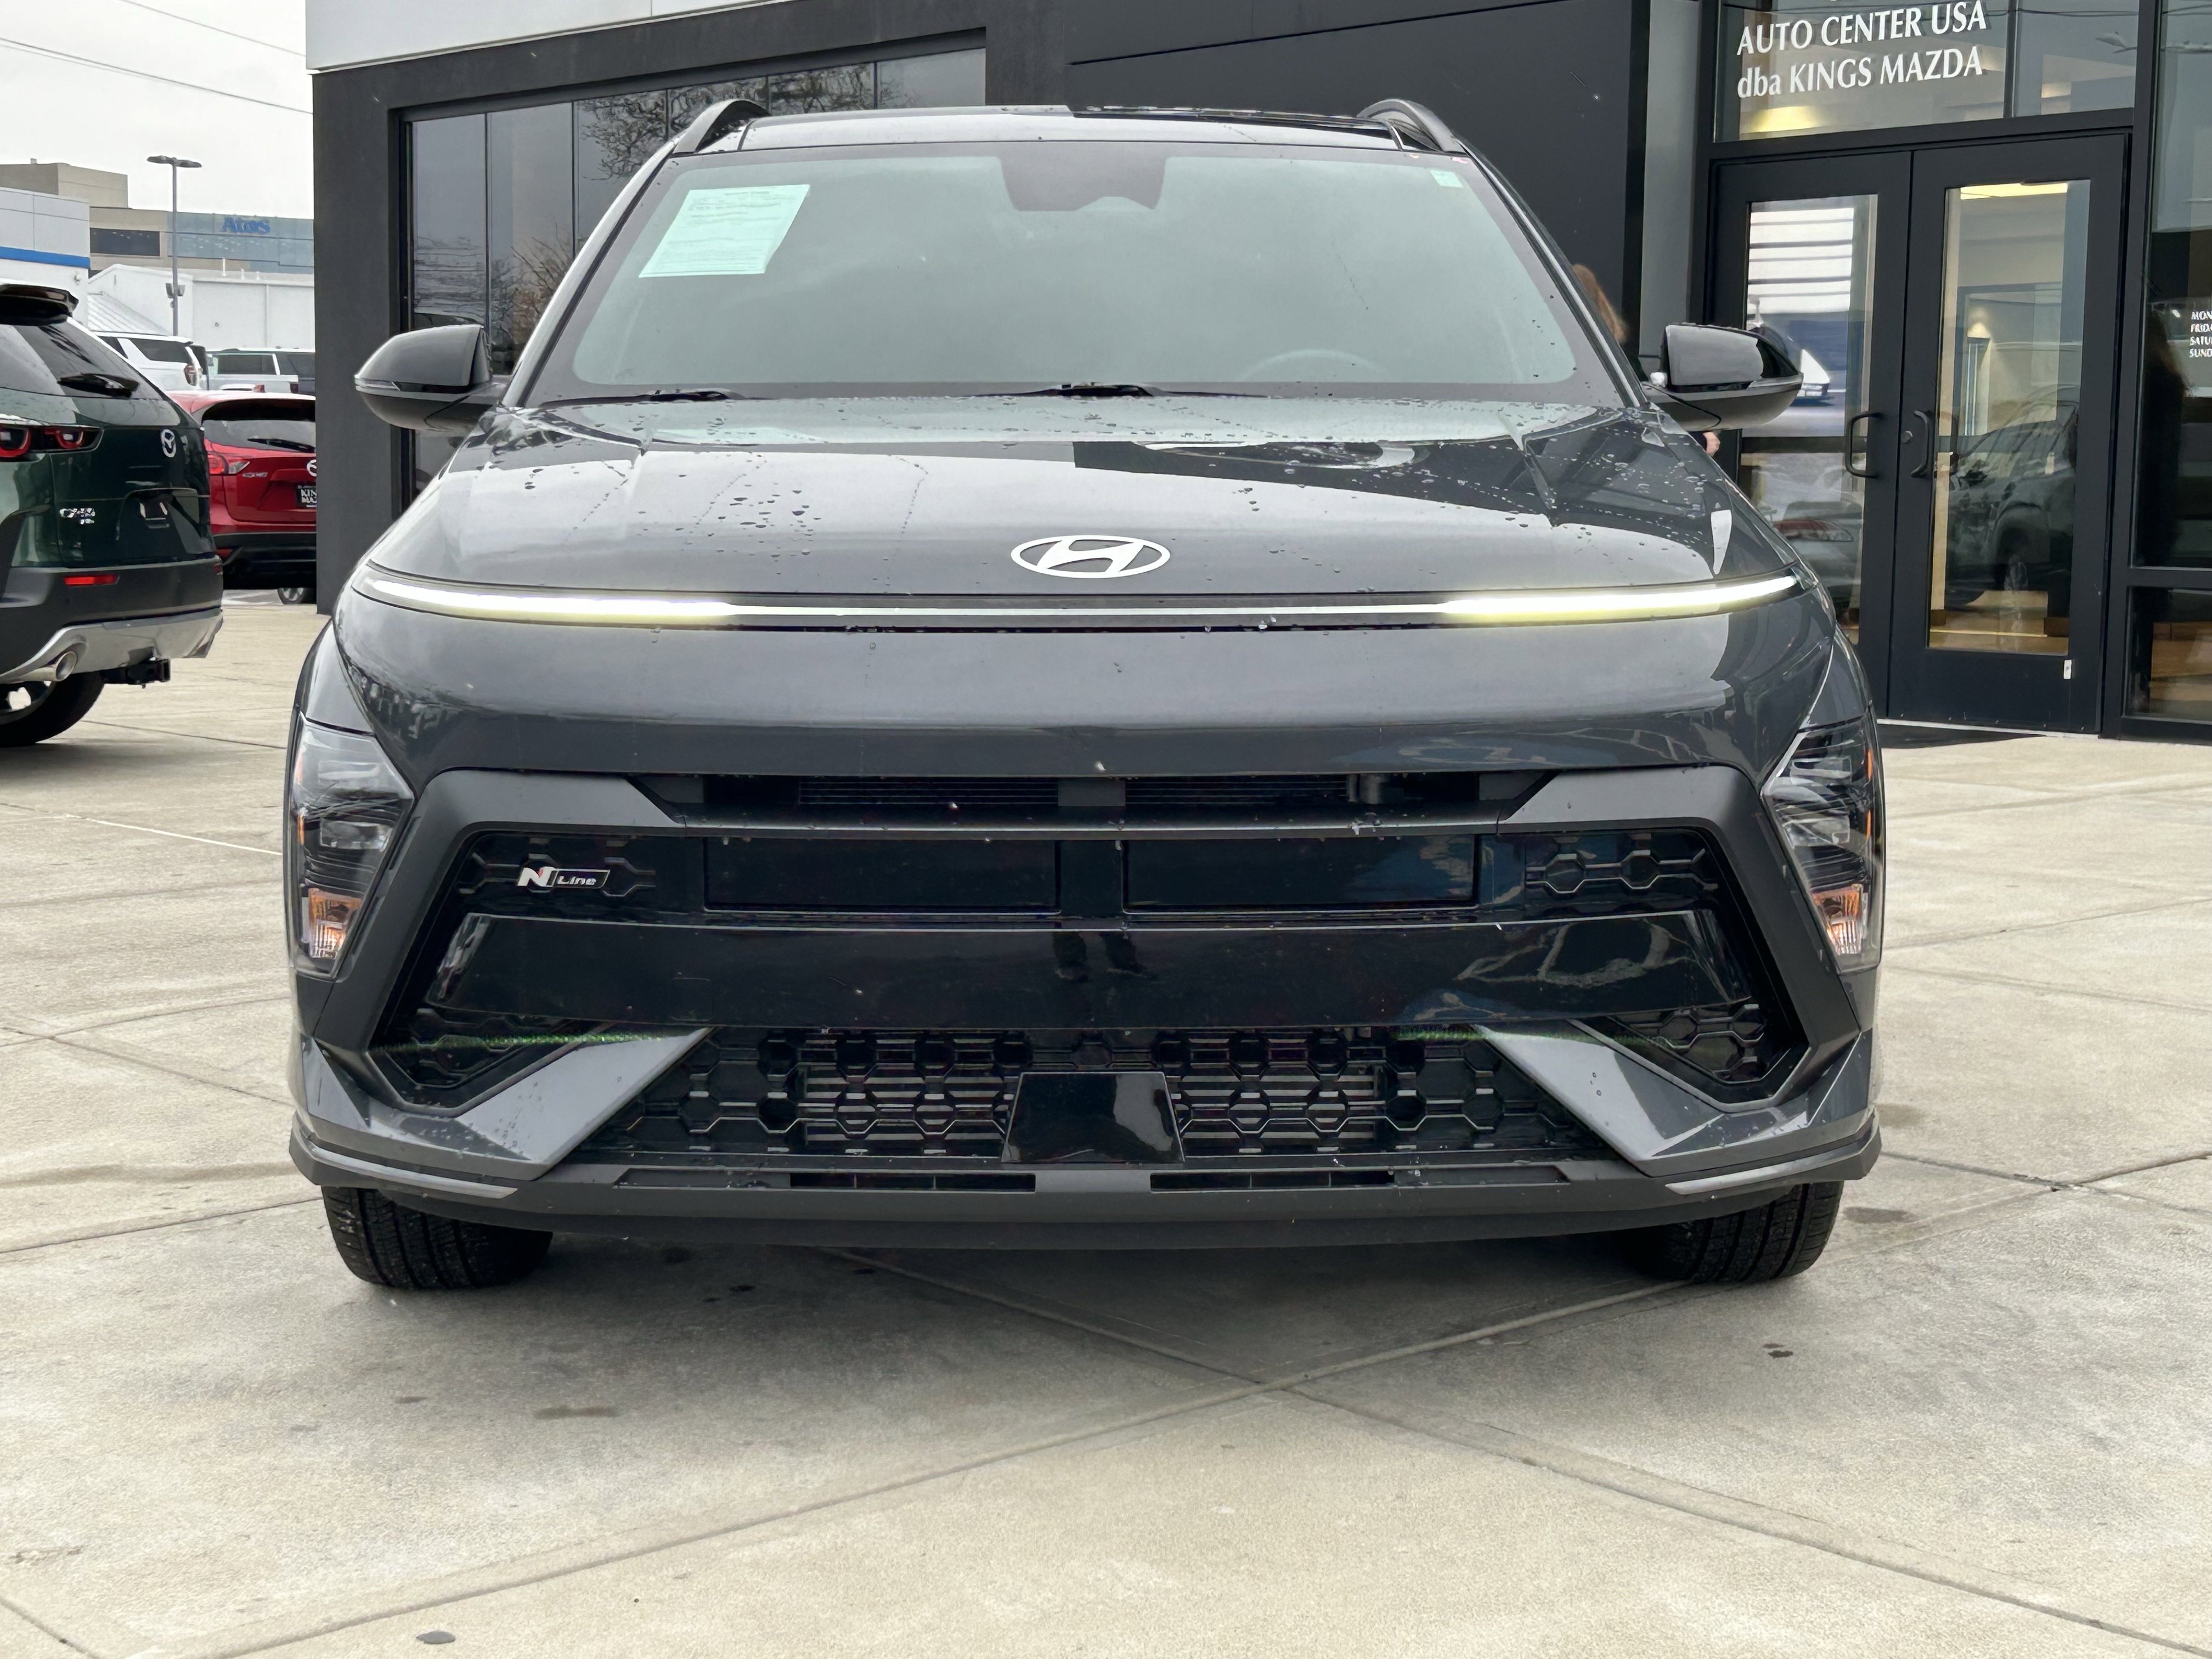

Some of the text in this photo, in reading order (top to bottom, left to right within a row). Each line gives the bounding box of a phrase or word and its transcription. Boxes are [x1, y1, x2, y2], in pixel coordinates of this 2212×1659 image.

[1736, 1, 1987, 55] AUTO CENTER USA
[1737, 46, 1983, 98] dba KINGS MAZDA
[517, 866, 596, 887] N Line
